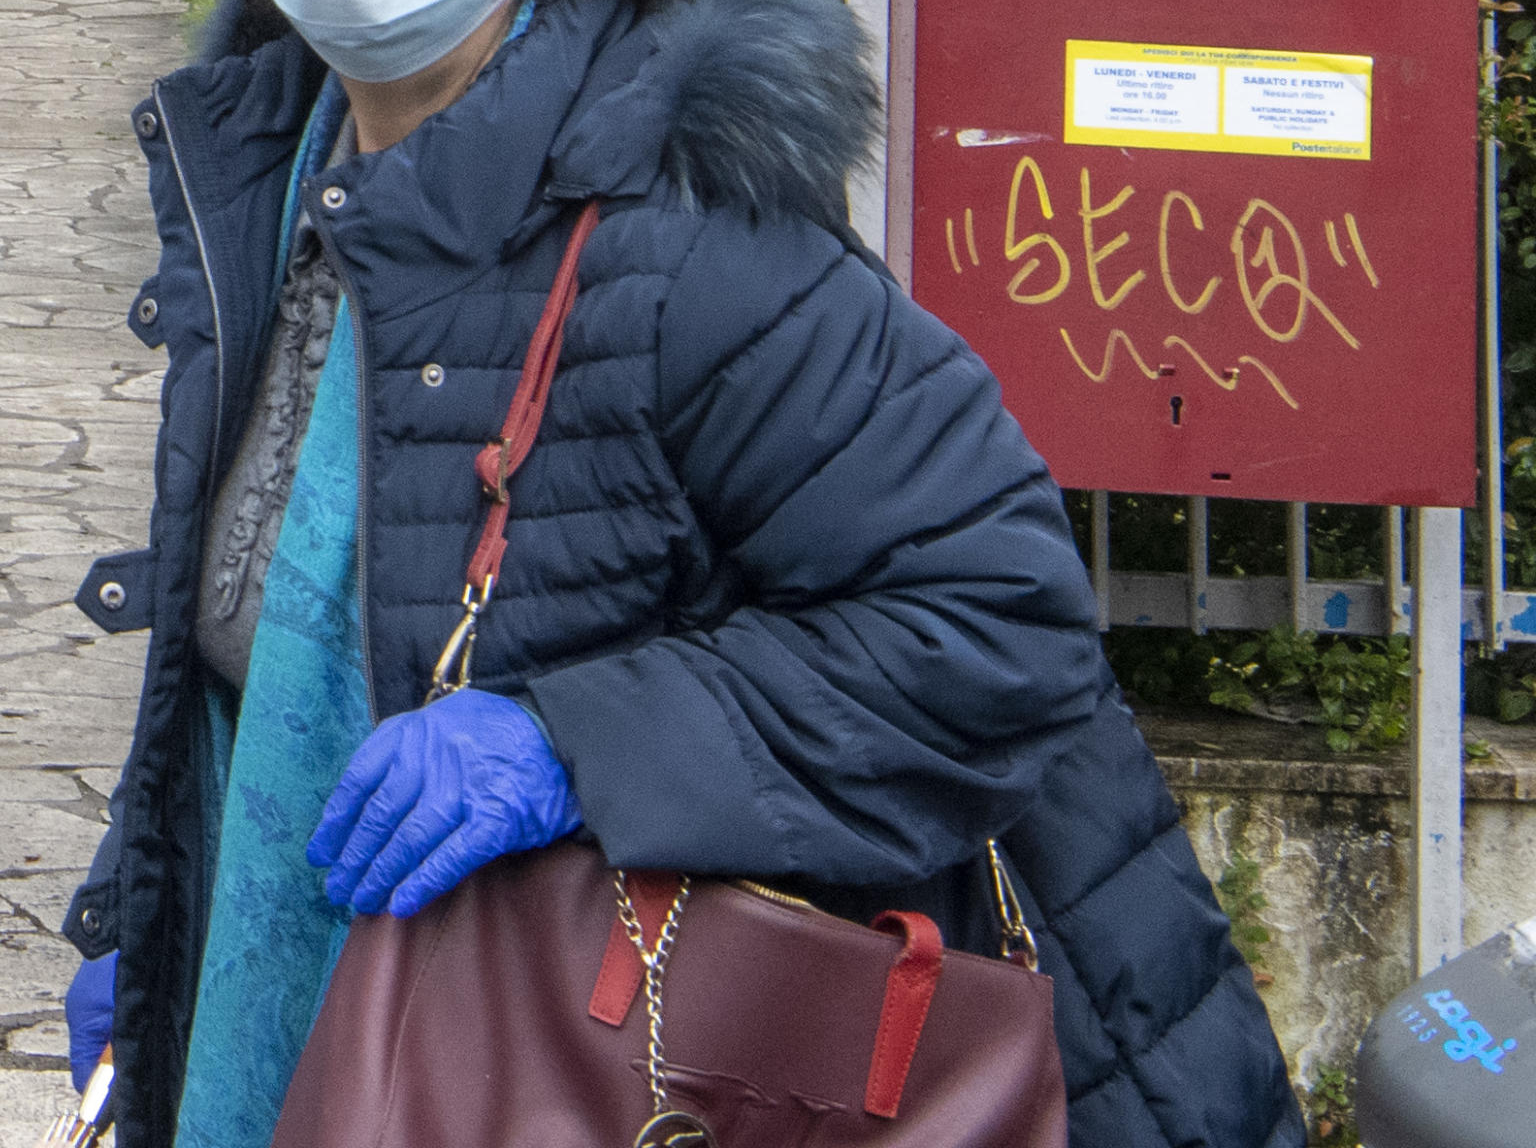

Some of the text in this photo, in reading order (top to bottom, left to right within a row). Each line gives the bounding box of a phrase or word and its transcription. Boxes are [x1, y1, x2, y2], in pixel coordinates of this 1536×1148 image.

[1242, 76, 1344, 89] SABATO E FESTIVI
